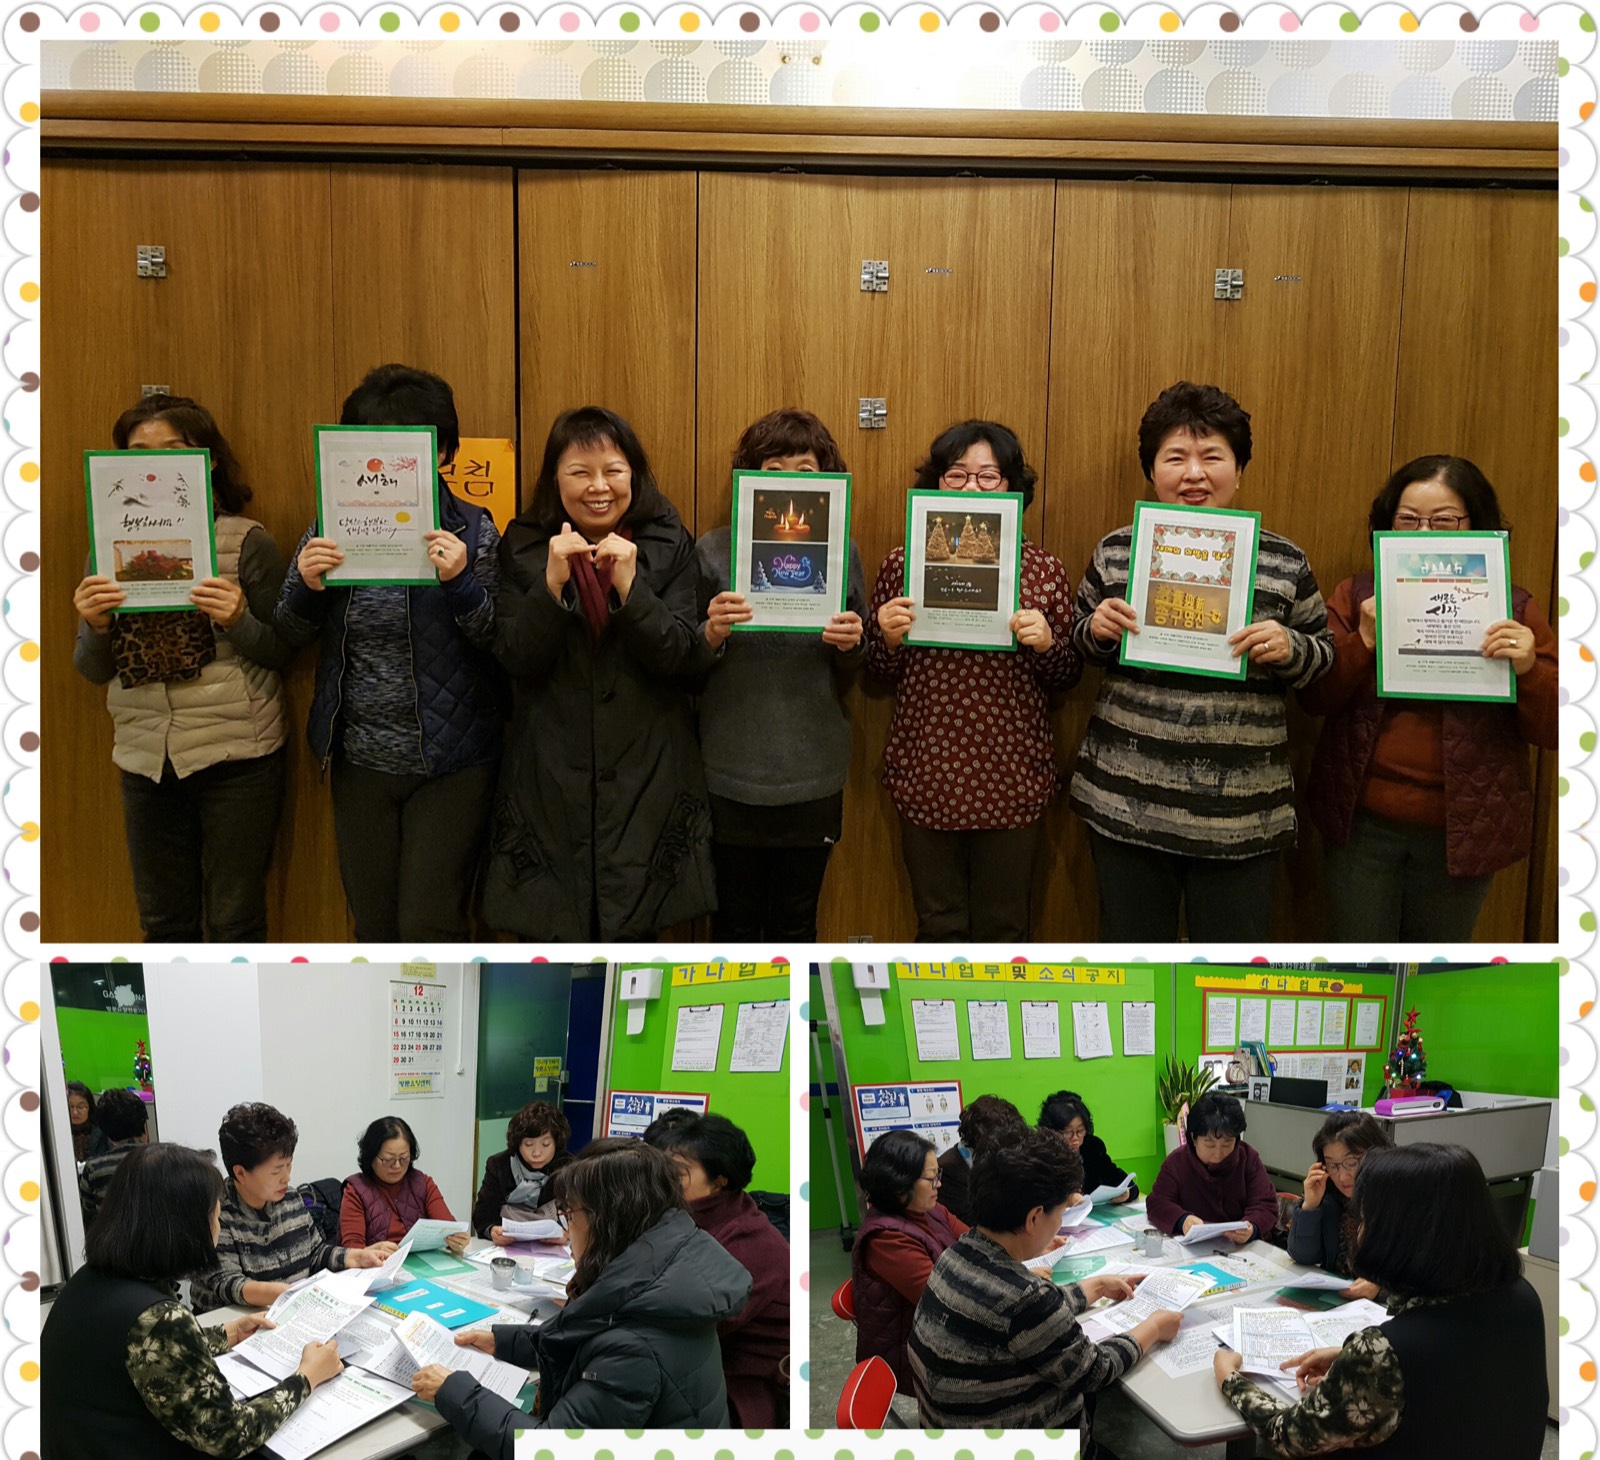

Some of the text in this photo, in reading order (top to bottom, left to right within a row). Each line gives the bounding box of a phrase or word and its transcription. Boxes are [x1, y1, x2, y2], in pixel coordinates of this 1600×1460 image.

[774, 555, 802, 570] Happy
[791, 568, 806, 578] Year
[1426, 604, 1460, 617] 시작
[679, 962, 724, 983] 가나
[902, 962, 1119, 983] 가나 업무 및 소식 공지
[414, 985, 423, 996] 12
